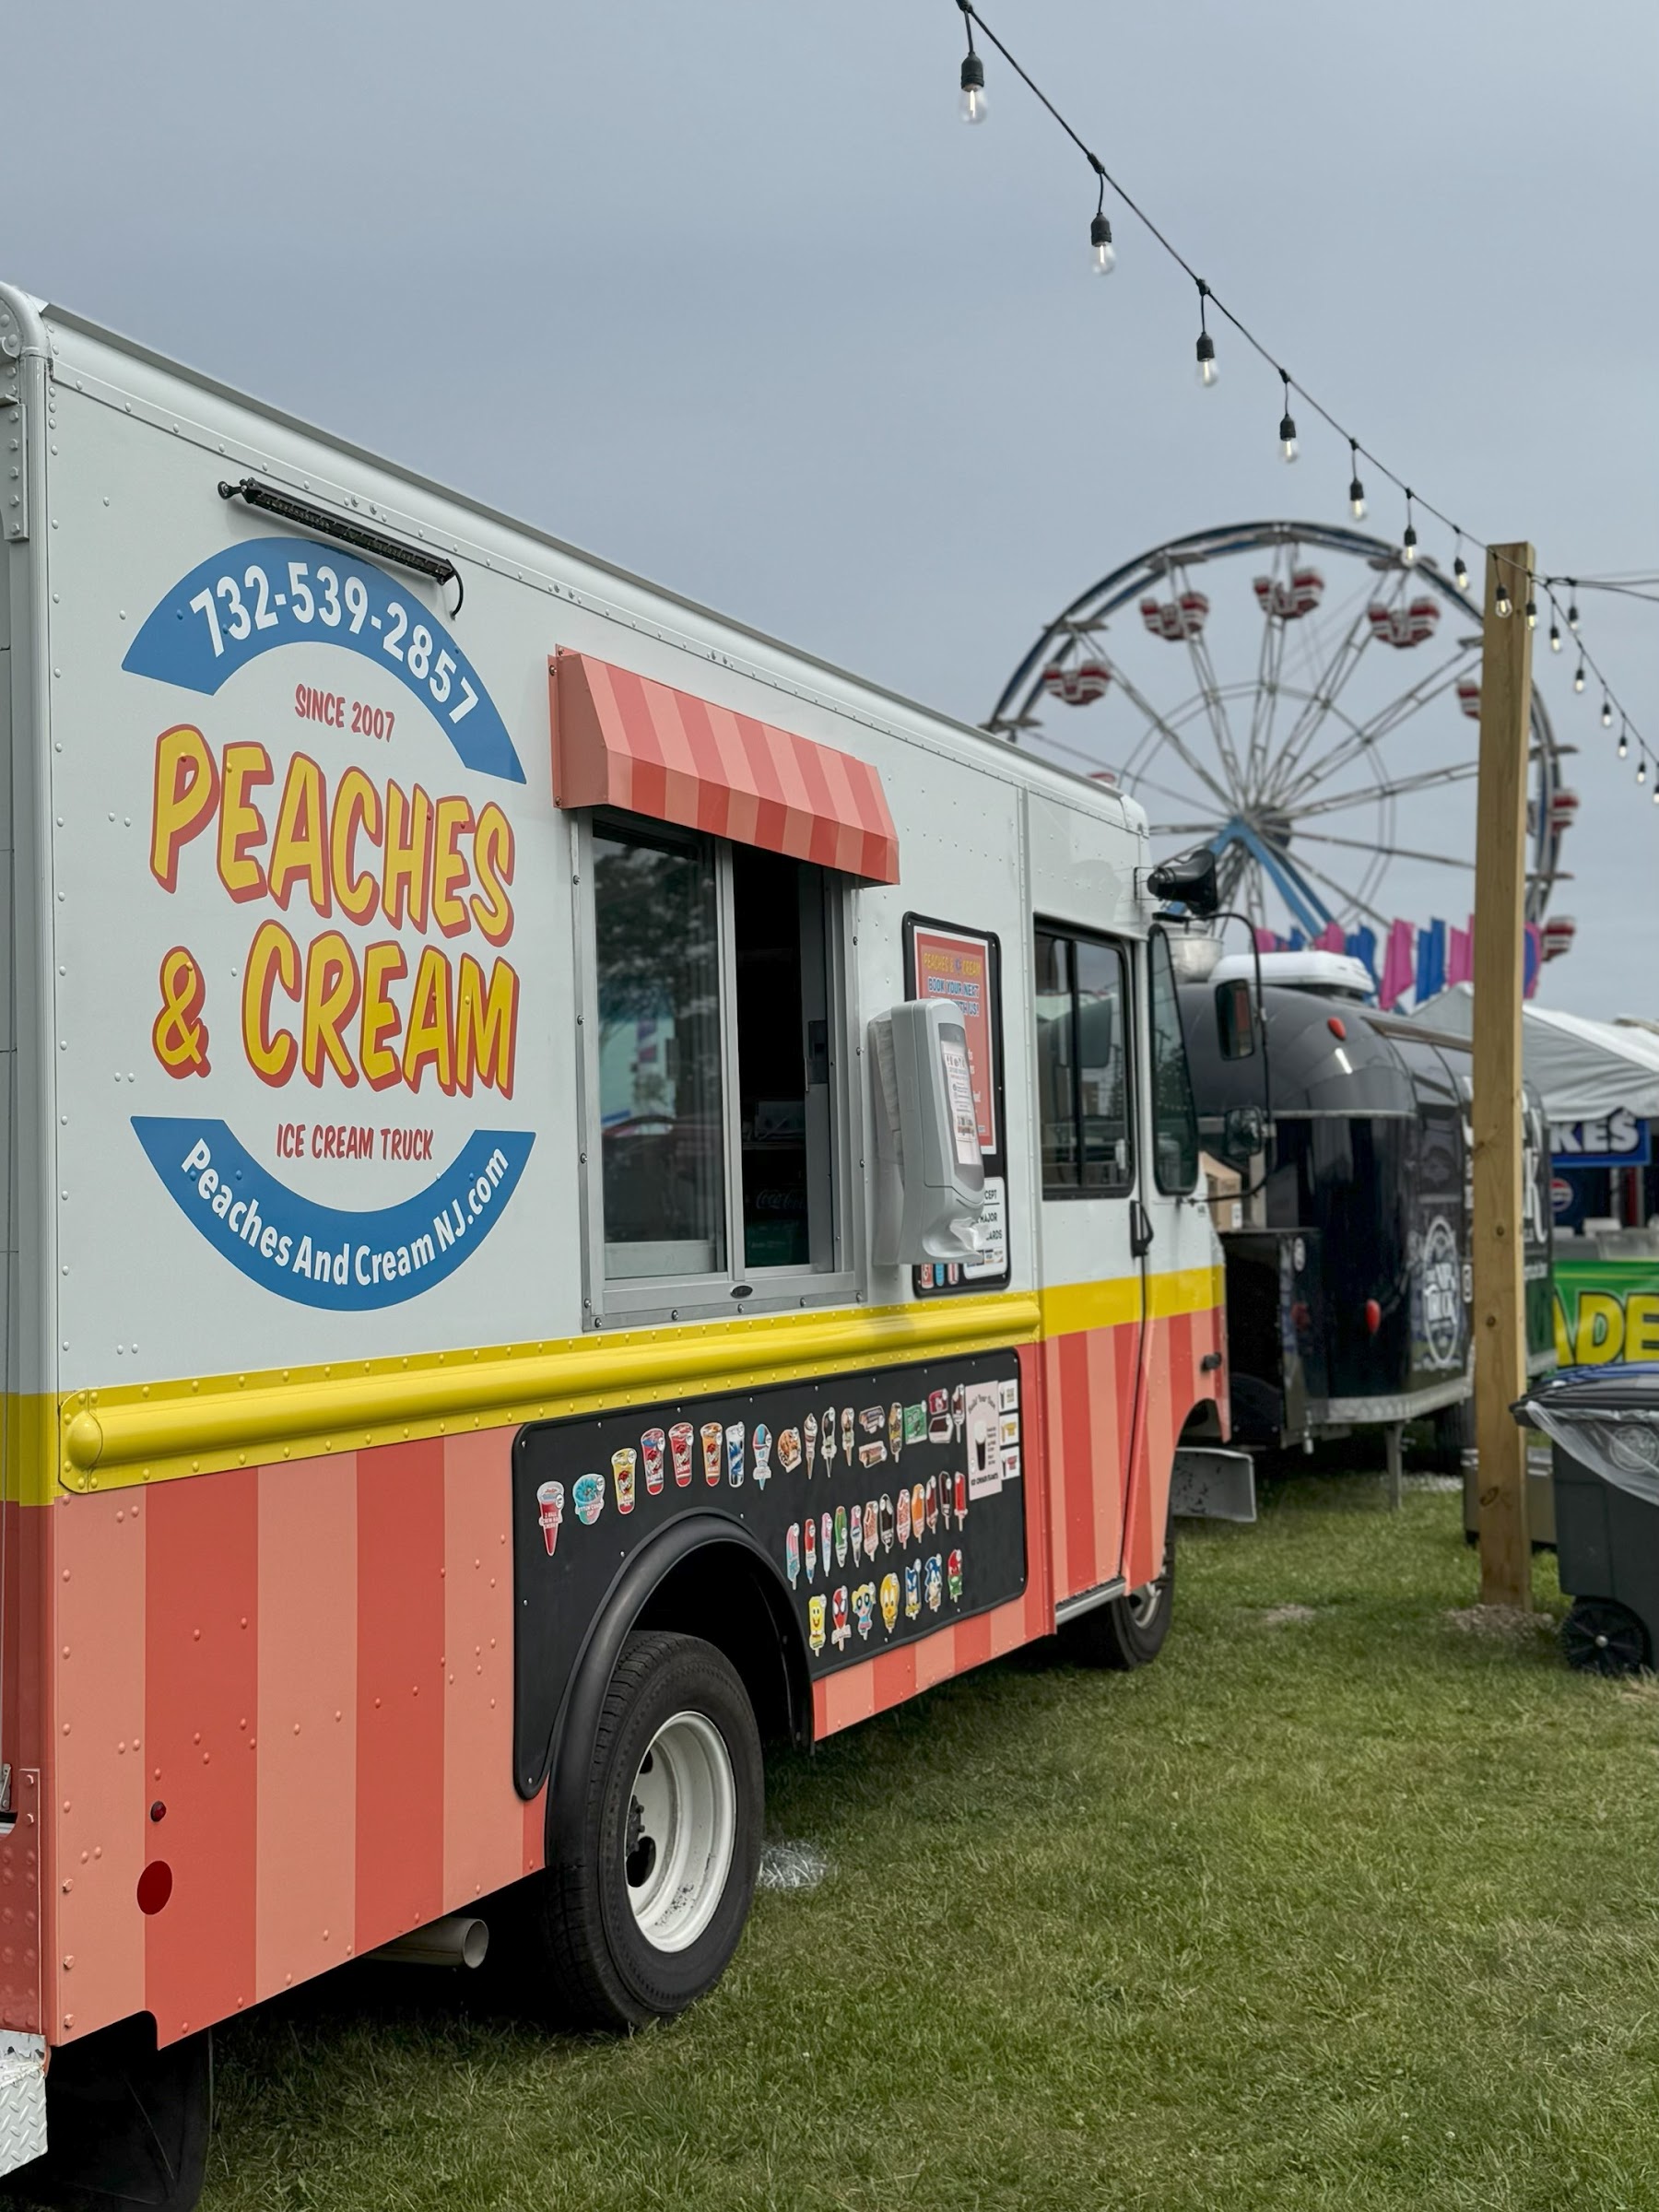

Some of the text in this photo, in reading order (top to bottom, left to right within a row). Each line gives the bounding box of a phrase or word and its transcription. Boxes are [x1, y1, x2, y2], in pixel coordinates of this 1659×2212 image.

[189, 561, 479, 724] 732-539-2857
[295, 683, 394, 743] SINCE 2007
[150, 724, 516, 947] PEACHES
[152, 919, 521, 1100] & CREAM
[928, 976, 946, 993] BOOK
[276, 1123, 434, 1161] ICE CREAM TRUCK
